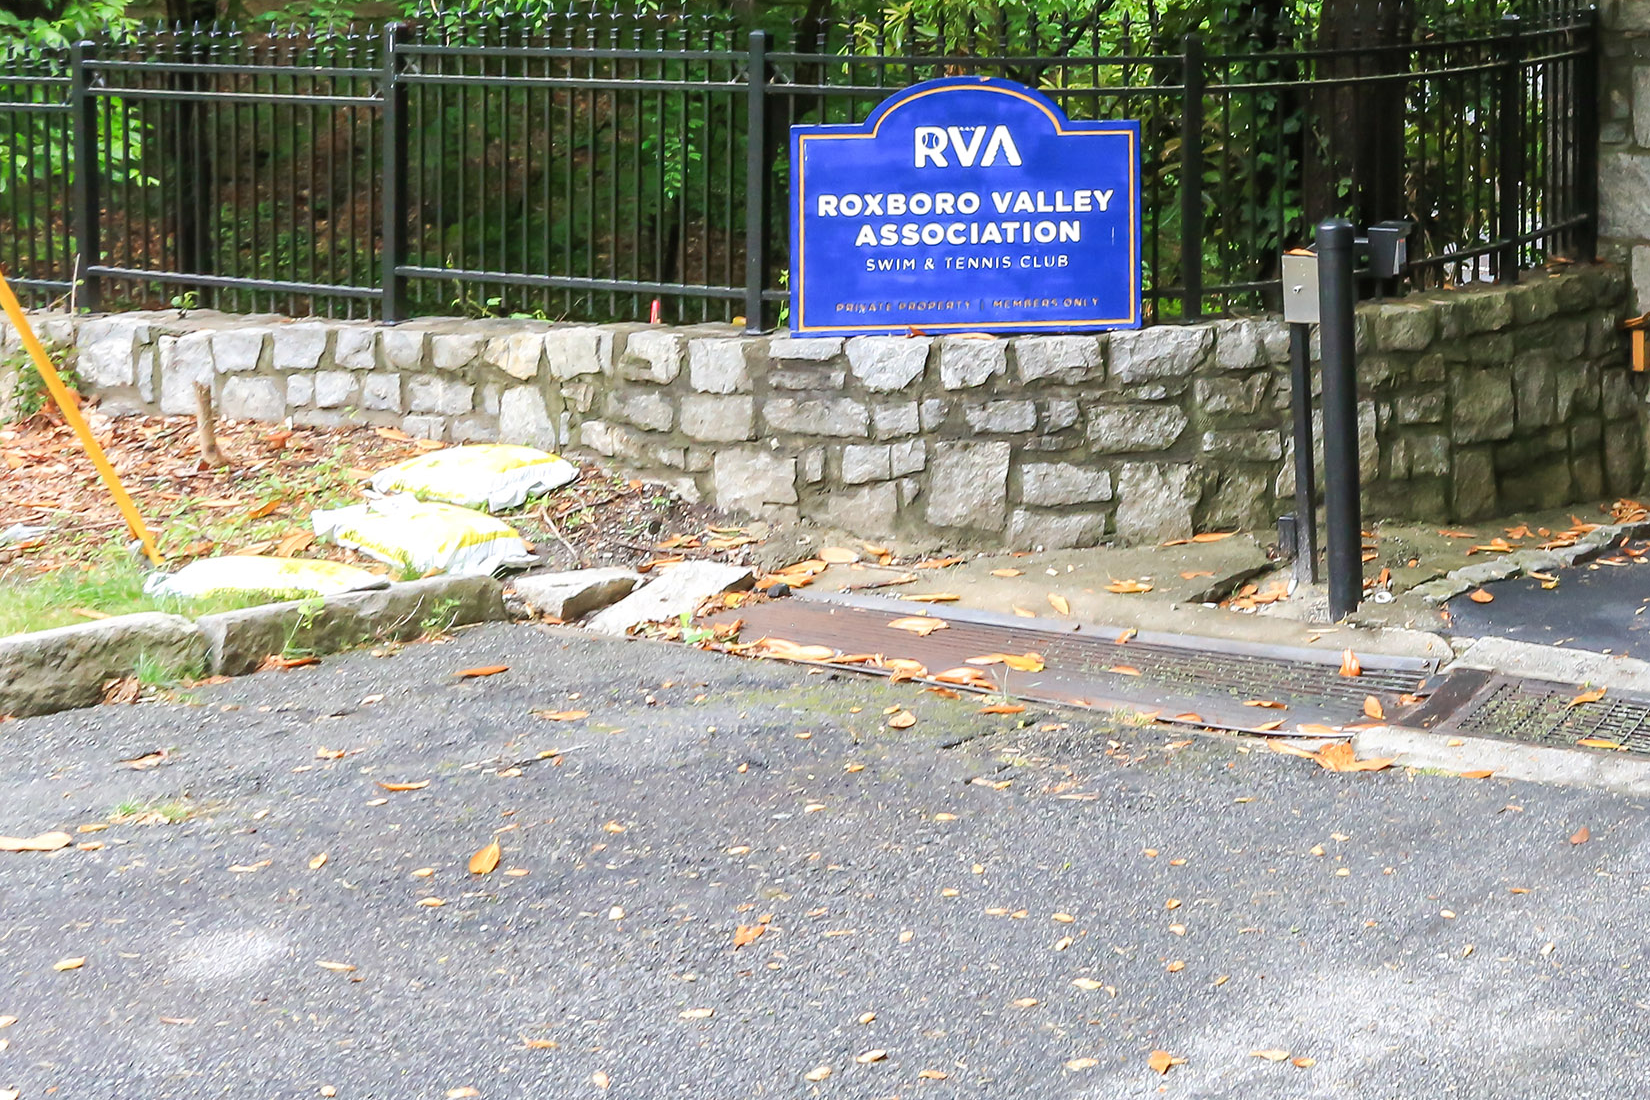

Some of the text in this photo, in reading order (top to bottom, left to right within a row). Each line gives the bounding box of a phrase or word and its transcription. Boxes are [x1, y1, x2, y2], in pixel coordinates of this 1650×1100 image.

[914, 125, 1023, 168] RVA
[818, 189, 1114, 218] ROXBORO VALLEY
[855, 221, 1081, 247] ASSOCIATION
[865, 254, 1069, 272] SWIM & TENNIS CLUB
[836, 297, 1099, 313] PRIVATE PROPERTY MEMBERS ONLY
